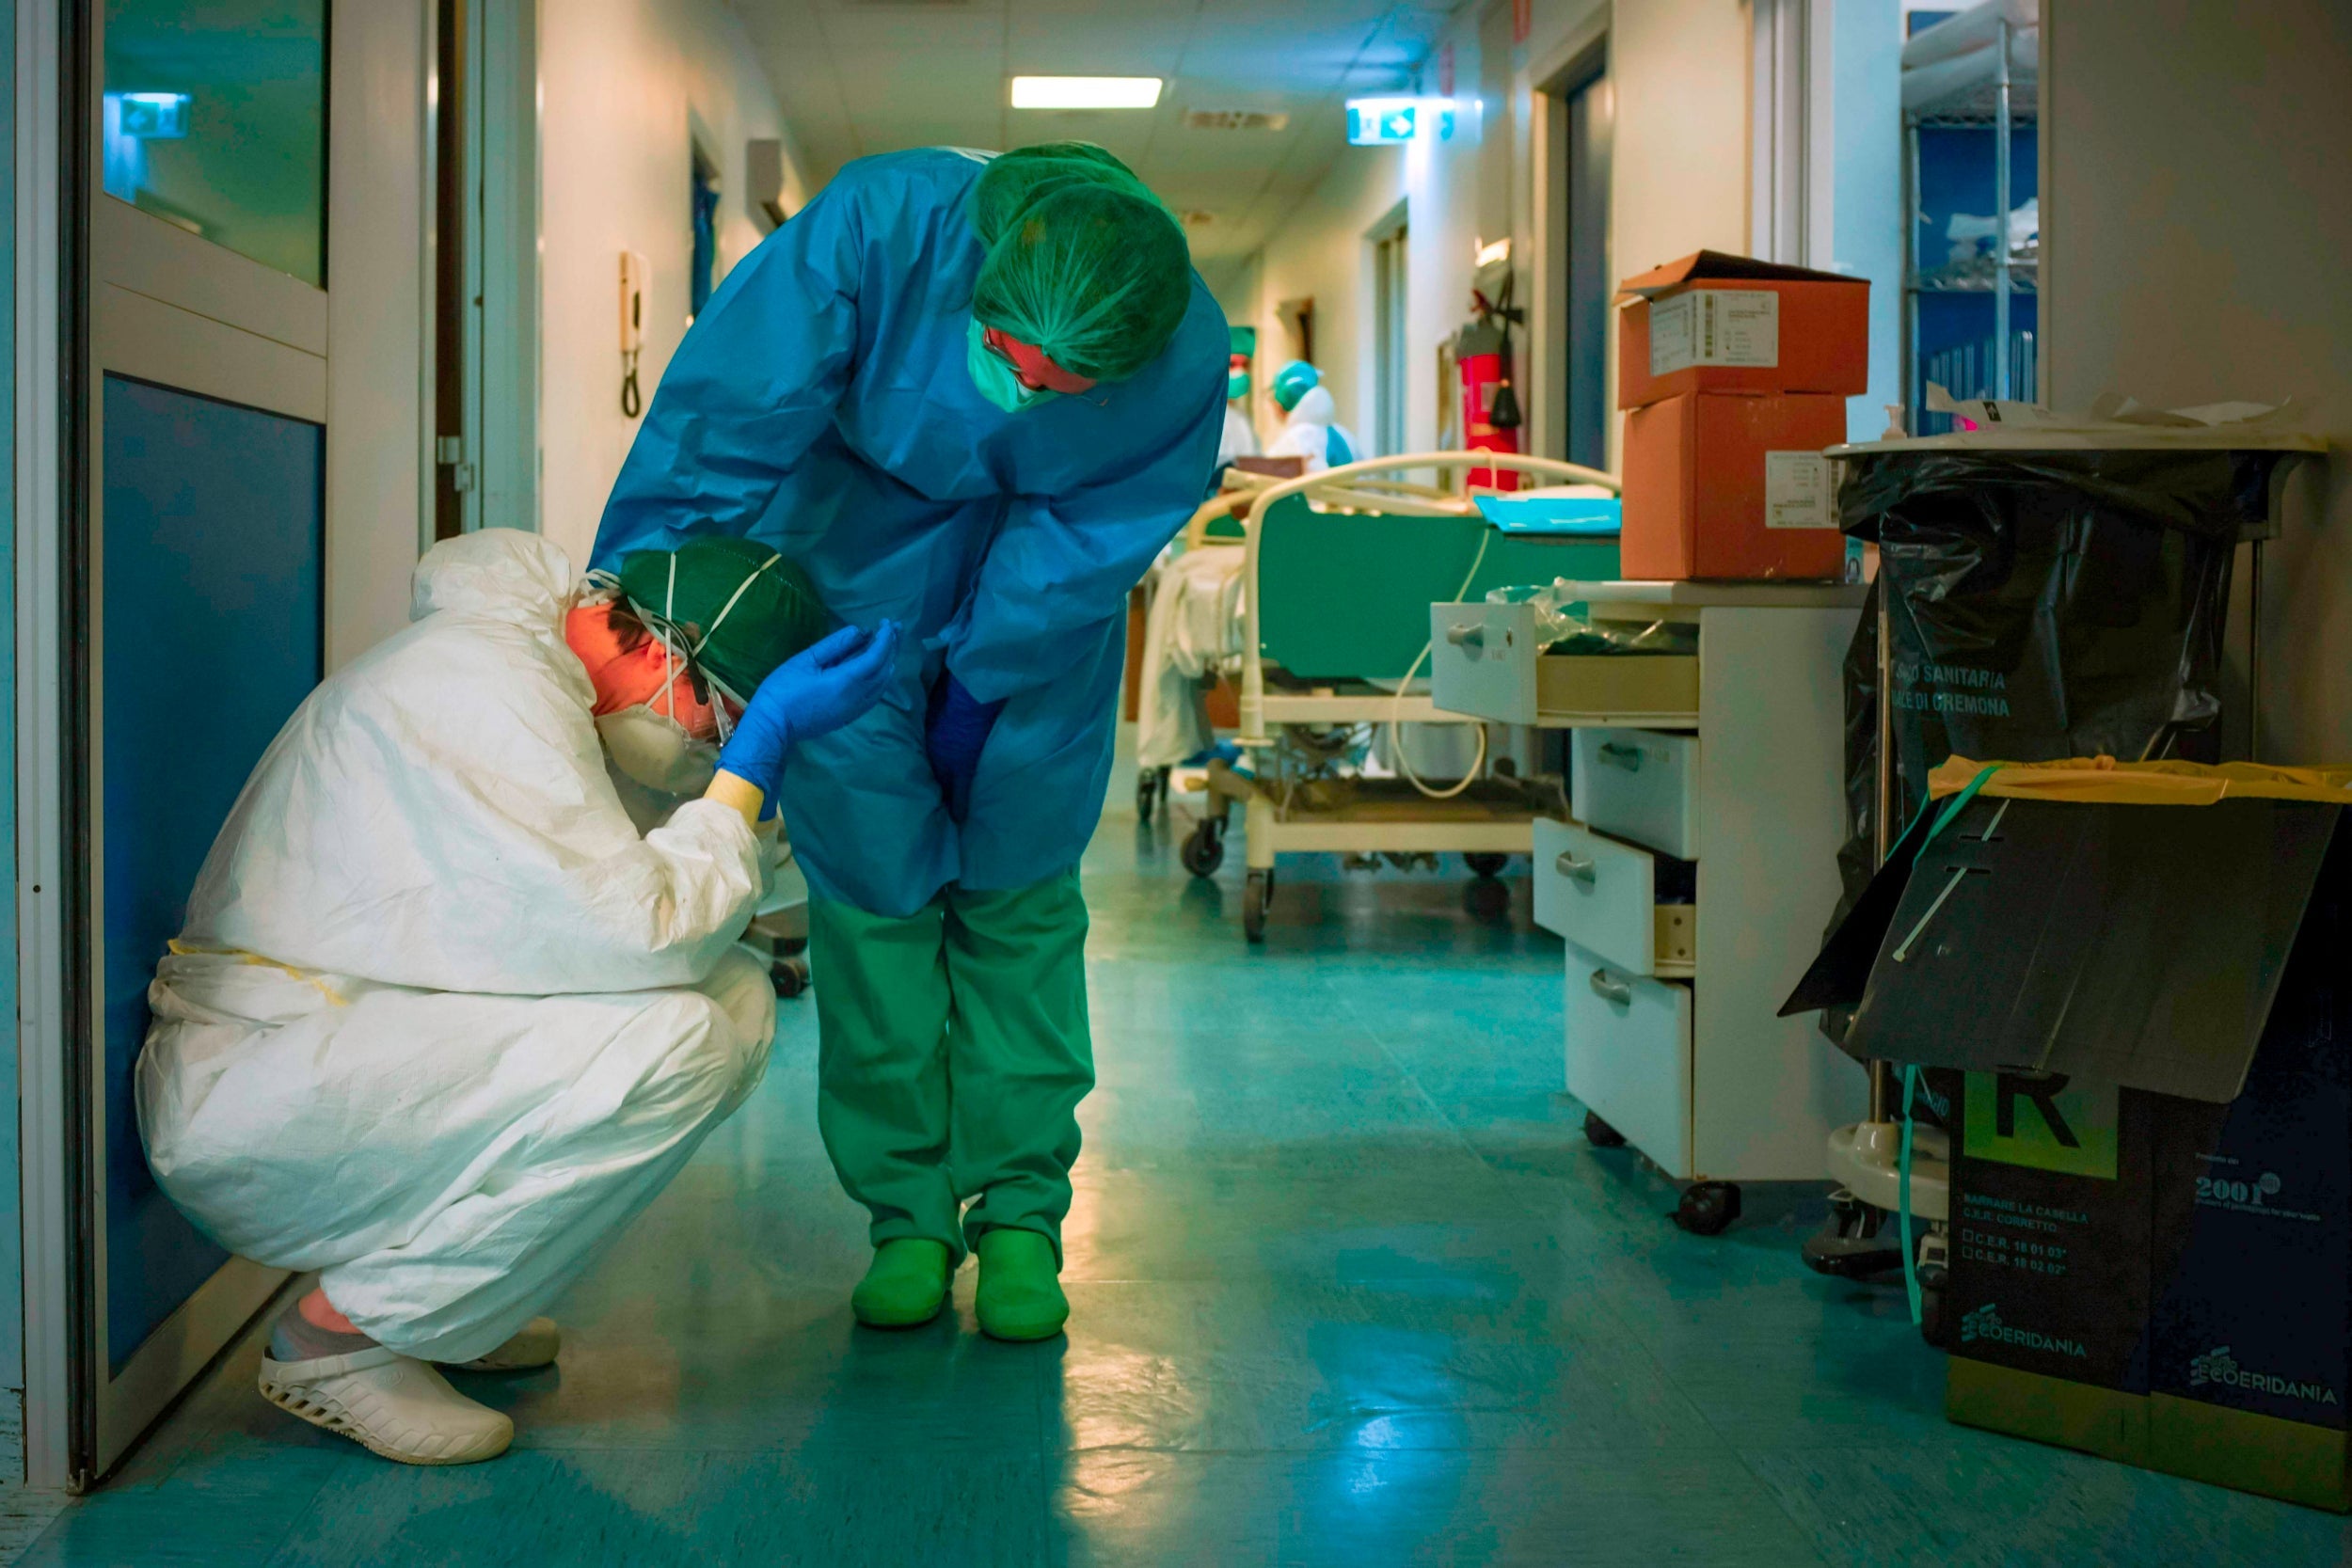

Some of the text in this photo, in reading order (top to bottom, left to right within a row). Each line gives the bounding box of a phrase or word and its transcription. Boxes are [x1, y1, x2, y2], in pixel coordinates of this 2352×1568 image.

[1924, 664, 2006, 690] SANITARIA
[1915, 691, 1929, 712] DI
[1933, 691, 2010, 718] CREMONA
[1996, 1072, 2081, 1148] R
[1996, 1213, 2058, 1233] CORRETTO
[2018, 1202, 2033, 1214] LA
[2035, 1205, 2089, 1225] CASELLA
[2014, 1241, 2027, 1253] 18
[2030, 1243, 2043, 1256] 01
[2014, 1257, 2027, 1269] 18
[2030, 1259, 2044, 1272] 02
[1969, 1320, 2087, 1358] ECOERIDANIA
[2199, 1363, 2339, 1405] ECOERIDANIA
